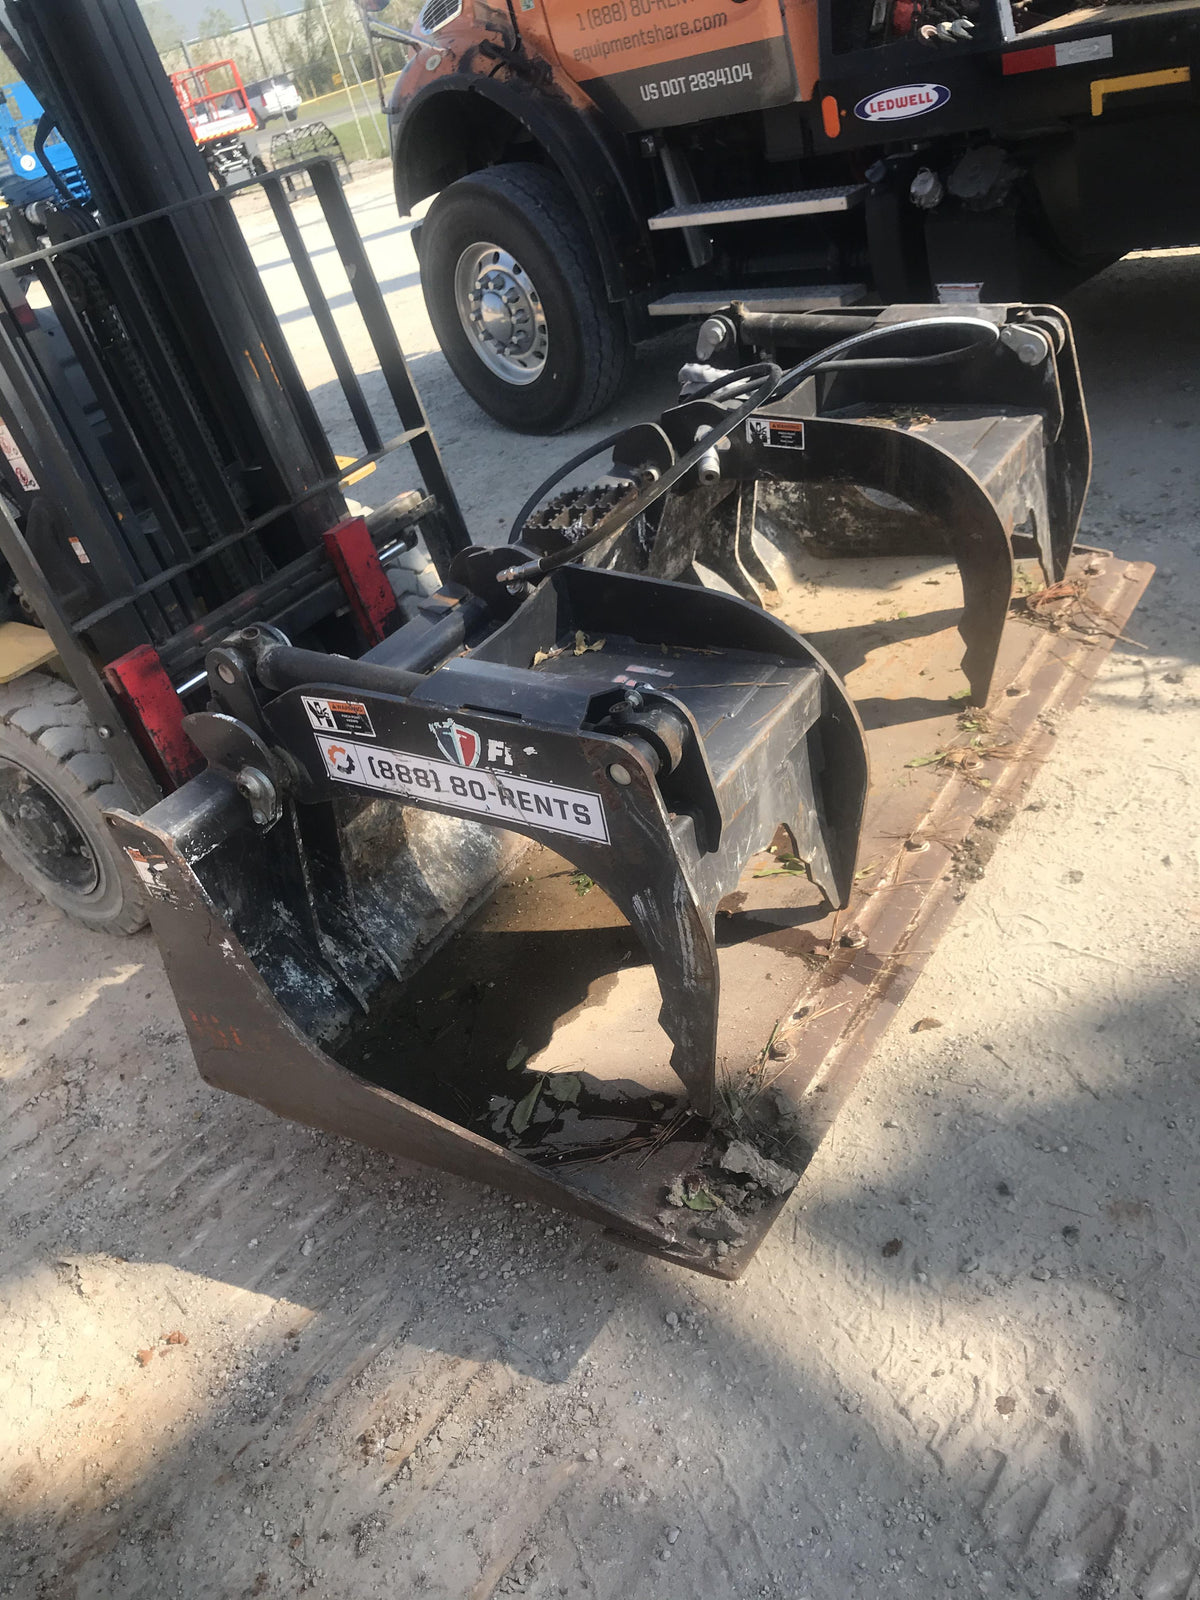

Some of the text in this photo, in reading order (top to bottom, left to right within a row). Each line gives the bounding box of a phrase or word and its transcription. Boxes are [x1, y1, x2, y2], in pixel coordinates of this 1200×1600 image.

[576, 13, 586, 31] 1
[587, 1, 627, 30] (888)
[573, 12, 728, 62] equipmentshare.com
[640, 63, 753, 101] US DOT 2834104
[869, 92, 934, 113] LEDWELL
[367, 756, 592, 826] (888) 80-RENTS
